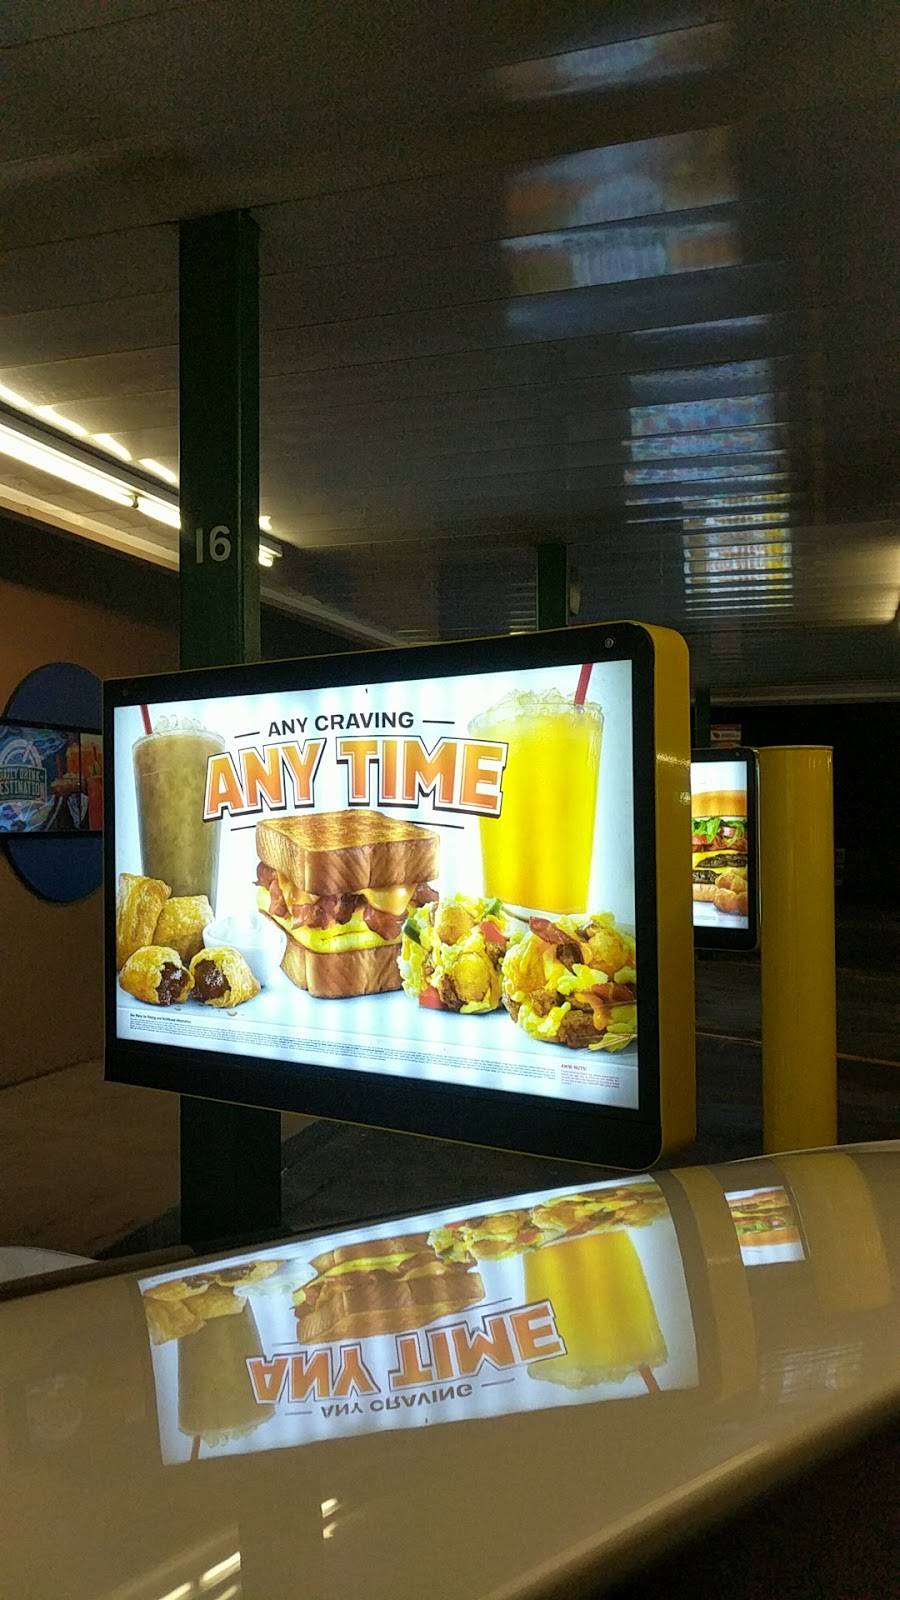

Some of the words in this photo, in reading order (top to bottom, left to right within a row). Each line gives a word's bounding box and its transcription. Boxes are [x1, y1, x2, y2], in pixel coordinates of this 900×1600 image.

[195, 525, 231, 563] 16
[268, 716, 308, 737] ANY
[314, 711, 414, 731] CRAVING
[203, 737, 327, 822] ANY
[336, 735, 509, 819] TIME
